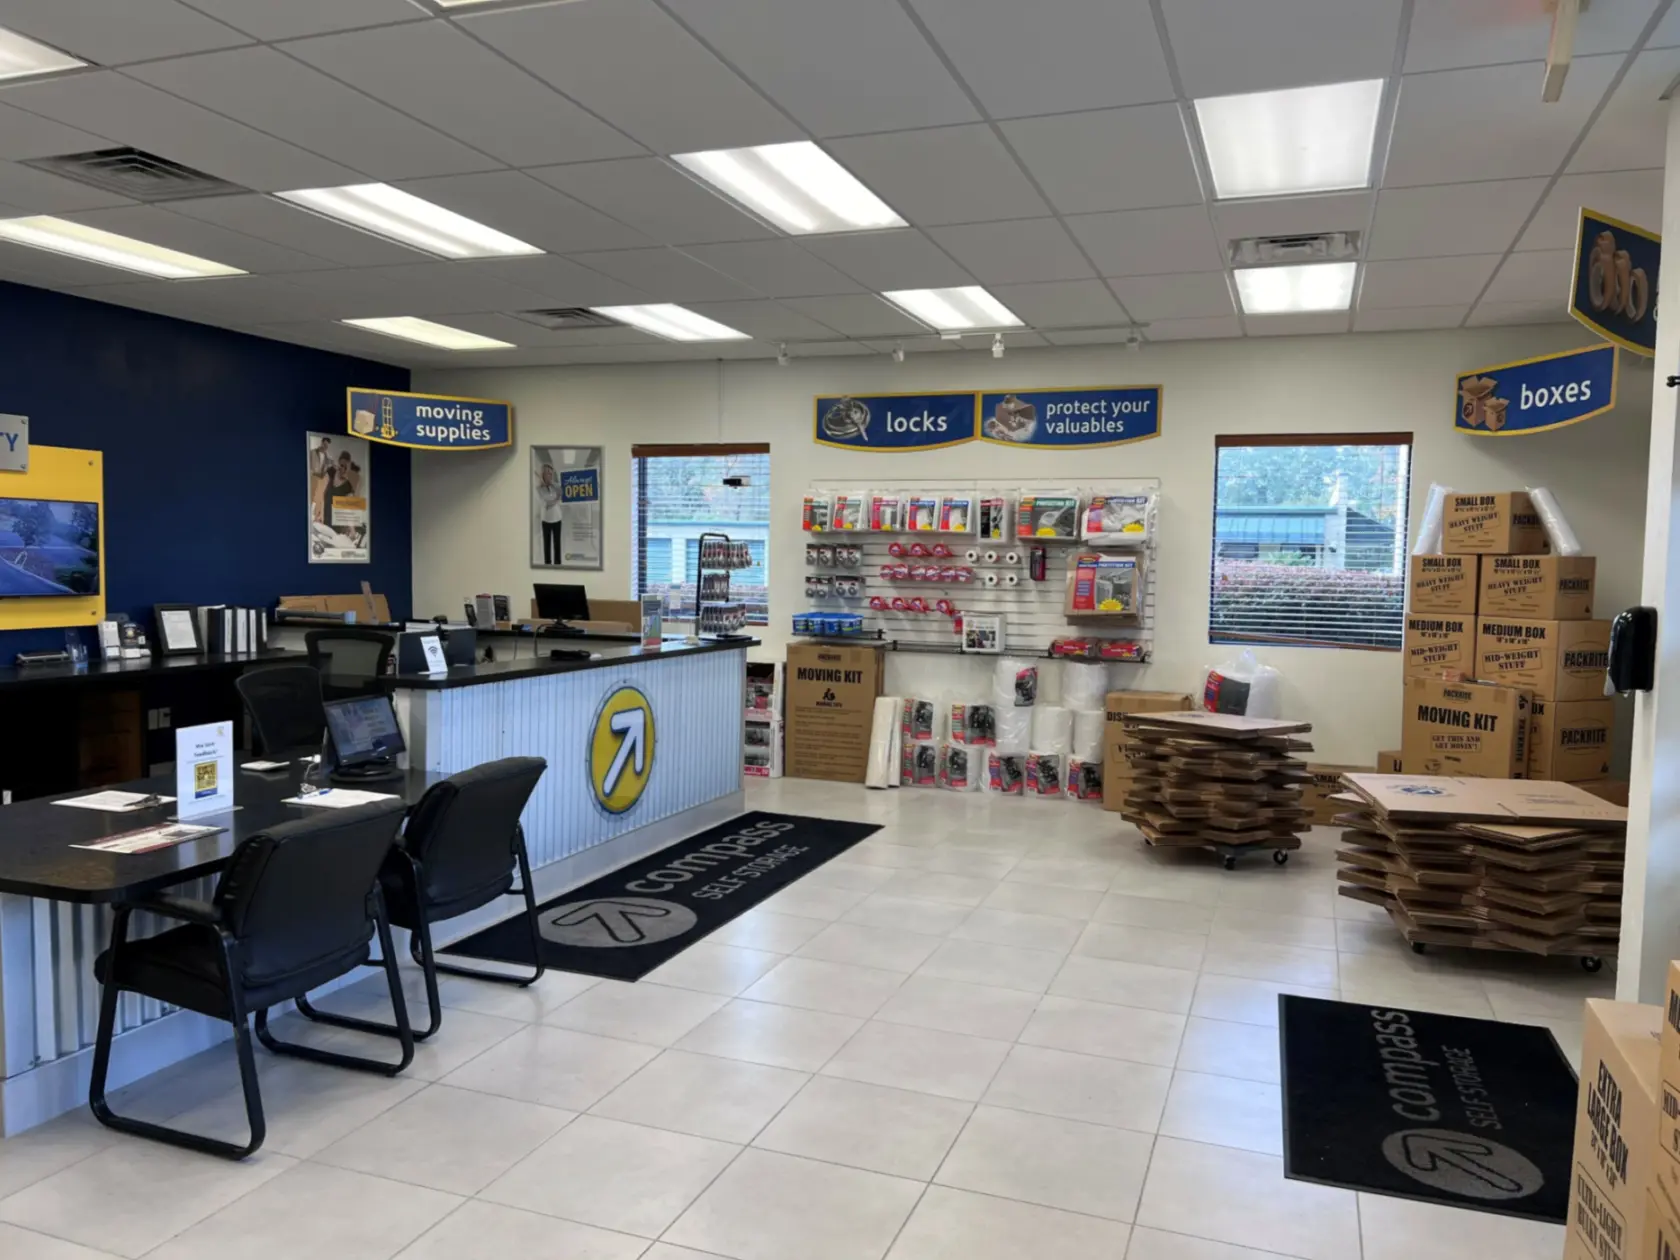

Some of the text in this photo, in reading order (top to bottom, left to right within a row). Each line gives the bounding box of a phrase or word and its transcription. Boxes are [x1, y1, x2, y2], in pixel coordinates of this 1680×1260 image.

[1520, 380, 1592, 410] boxes
[416, 404, 484, 426] moving
[1046, 398, 1151, 418] protect your
[886, 410, 948, 433] locks
[1046, 417, 1125, 434] valuables
[416, 423, 491, 442] supplies
[565, 484, 593, 498] OPEN
[1454, 496, 1496, 506] SMALL BOX
[1423, 558, 1462, 567] SMALL BOX
[1494, 558, 1541, 569] SMALL BOX
[1559, 578, 1590, 591] PACKRITE
[1408, 619, 1464, 632] MEDIUM BOX
[1483, 624, 1546, 639] MEDIUM BOX
[1411, 644, 1458, 656] MID-WEIGHT
[1485, 650, 1538, 662] MID-WEIGHT
[1498, 661, 1526, 669] STUFF
[797, 667, 863, 684] MOVING KIT
[1443, 688, 1473, 700] PACKRITE
[1417, 705, 1498, 732] MOVING KIT
[1561, 728, 1607, 745] PACKRITE
[625, 821, 795, 893] compass
[691, 844, 810, 900] SELF STORAGE
[1371, 1010, 1441, 1121] compass
[1441, 1044, 1503, 1129] SELF STORAGE
[1597, 1058, 1622, 1130] EXTRA
[1587, 1080, 1629, 1185] LARGE BOX
[1577, 1173, 1622, 1251] ULTRA-LIGHT
[1578, 1201, 1599, 1249] BULKY
